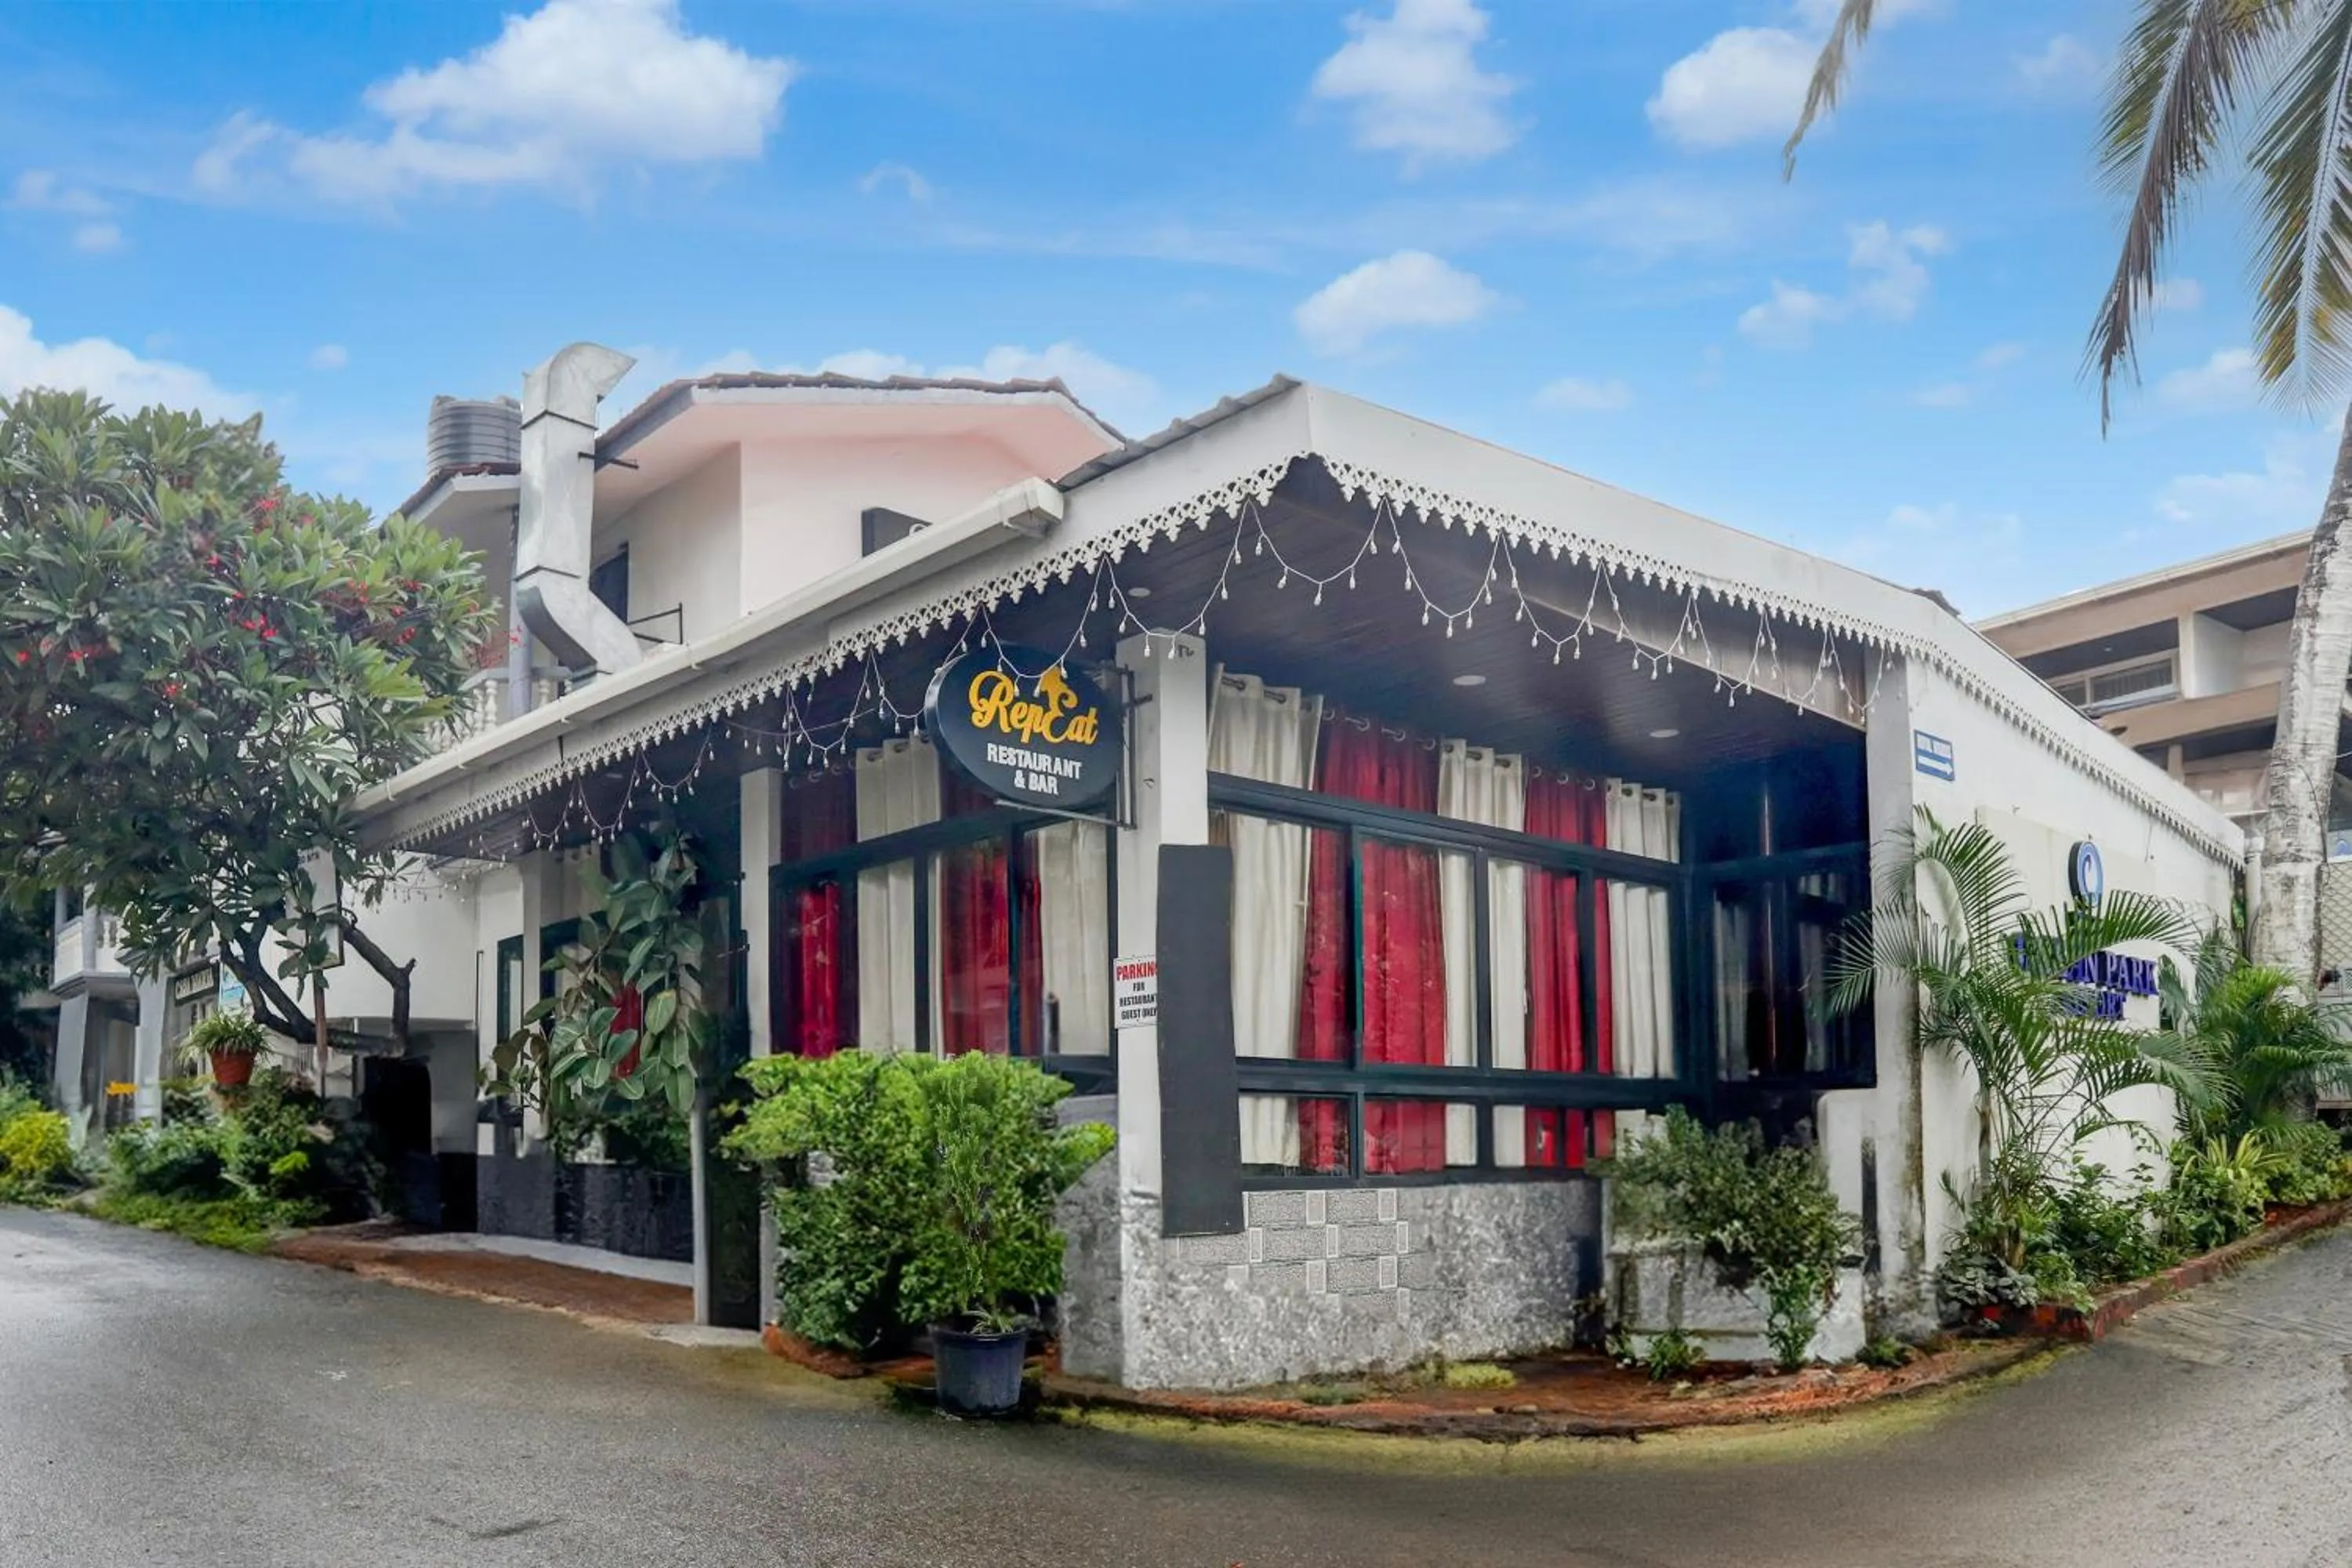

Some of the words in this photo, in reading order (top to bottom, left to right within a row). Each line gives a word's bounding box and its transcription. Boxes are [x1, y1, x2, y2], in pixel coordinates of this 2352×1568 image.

[969, 666, 1098, 744] RepEat
[987, 742, 1082, 779] RESTAURANT
[1014, 770, 1025, 789] &
[1029, 772, 1058, 795] BAR
